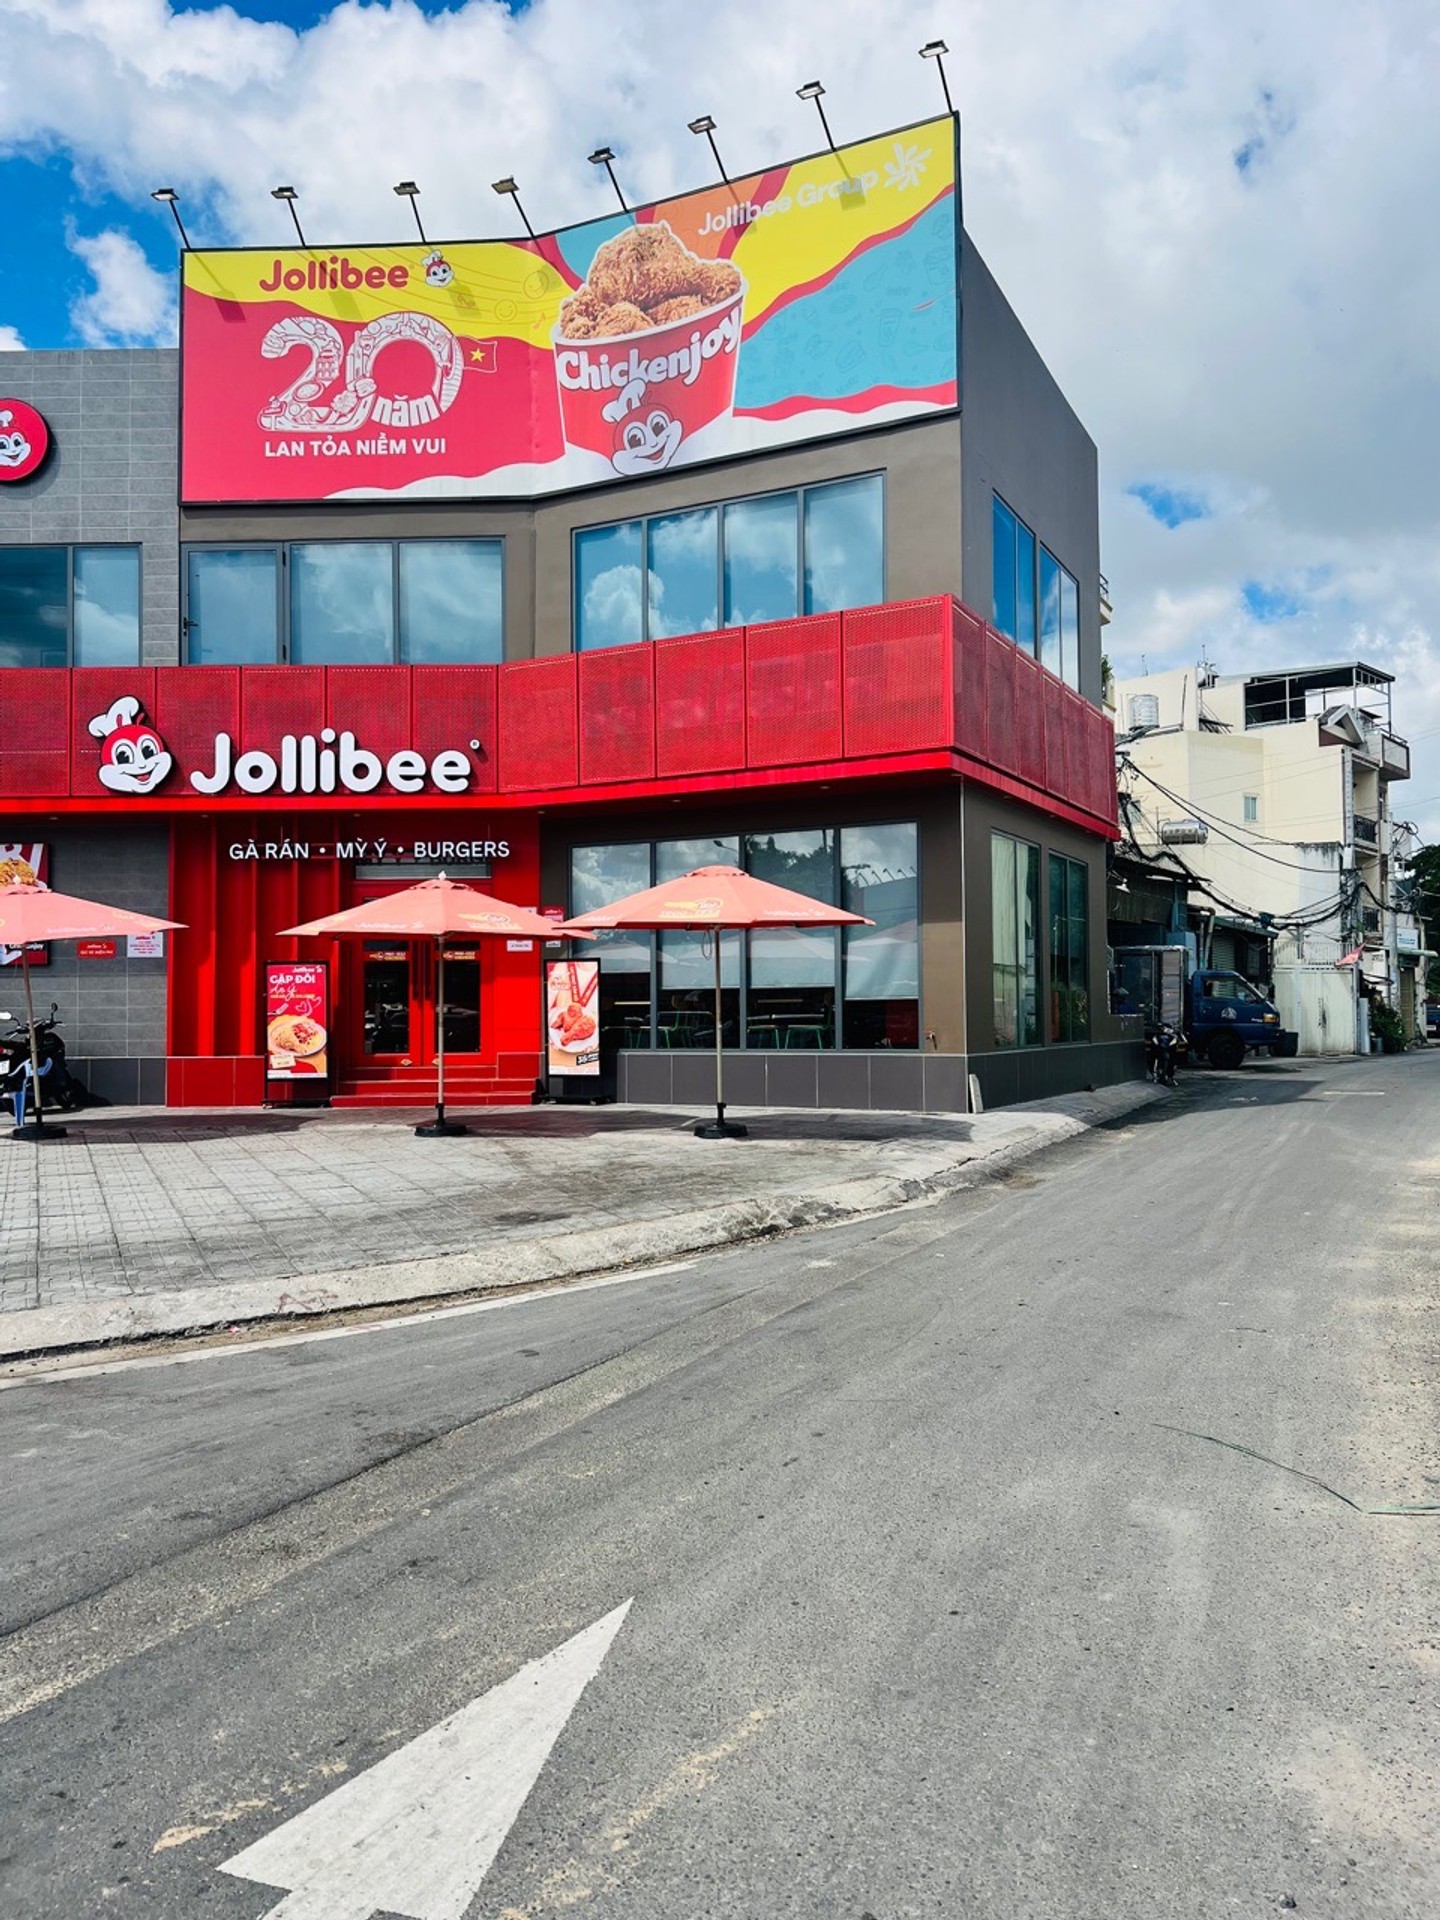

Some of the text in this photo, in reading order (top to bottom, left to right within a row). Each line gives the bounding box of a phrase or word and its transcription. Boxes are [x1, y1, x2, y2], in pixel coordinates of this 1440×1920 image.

[697, 169, 879, 236] Jollibee Group
[259, 255, 410, 292] Jollibee
[257, 311, 464, 433] 20
[556, 305, 742, 391] Chickenjoy
[370, 394, 441, 428] năm
[264, 439, 305, 457] LAN
[309, 435, 353, 457] TỎA
[411, 438, 447, 455] VUI
[190, 727, 471, 794] Jollibee
[229, 837, 511, 860] GÀ RÁN MỲ Ý BURGERS
